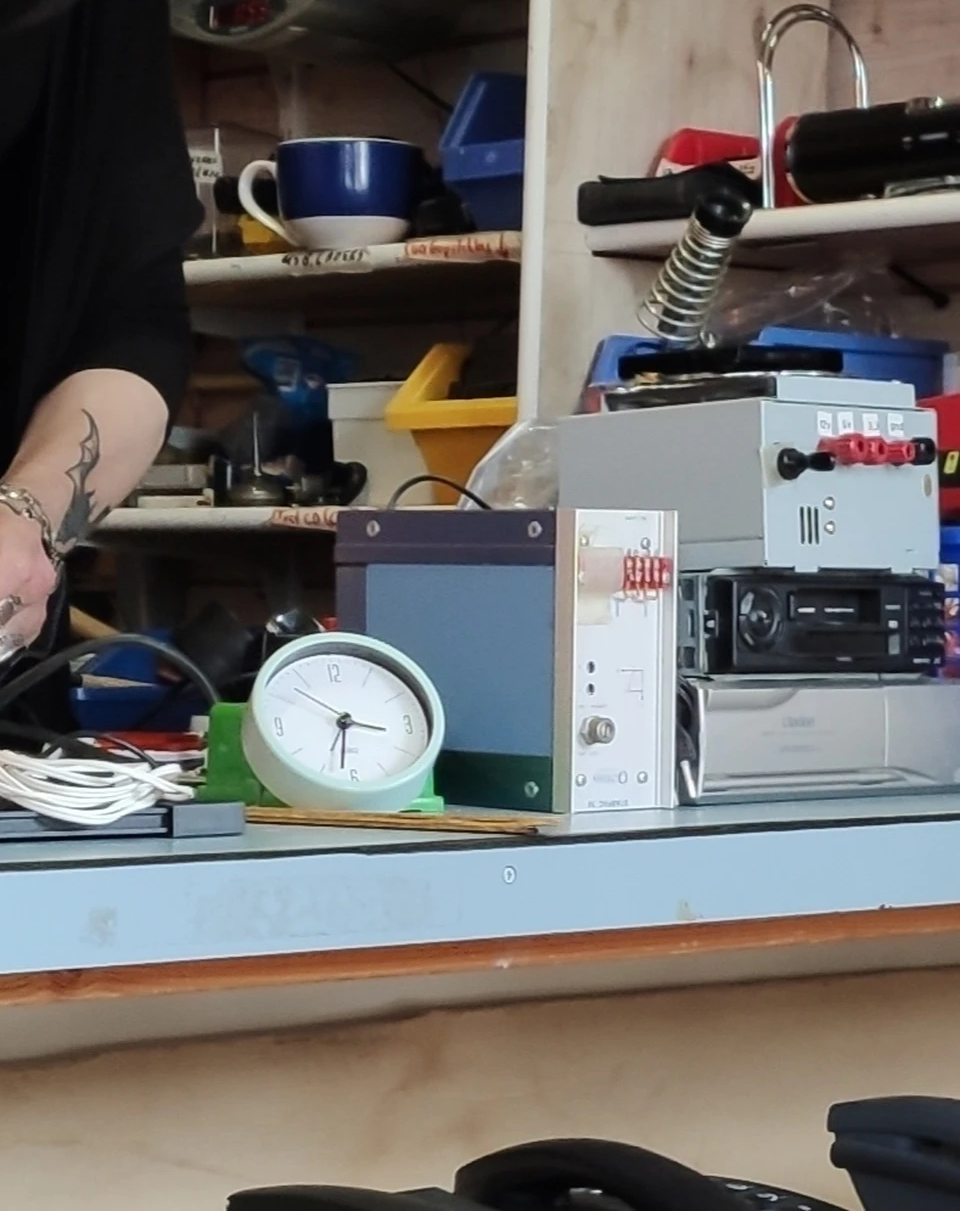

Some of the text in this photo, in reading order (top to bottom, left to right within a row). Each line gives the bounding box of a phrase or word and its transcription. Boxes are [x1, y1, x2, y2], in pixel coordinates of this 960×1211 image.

[327, 663, 342, 683] 12
[273, 716, 284, 737] 9
[403, 714, 414, 735] 3
